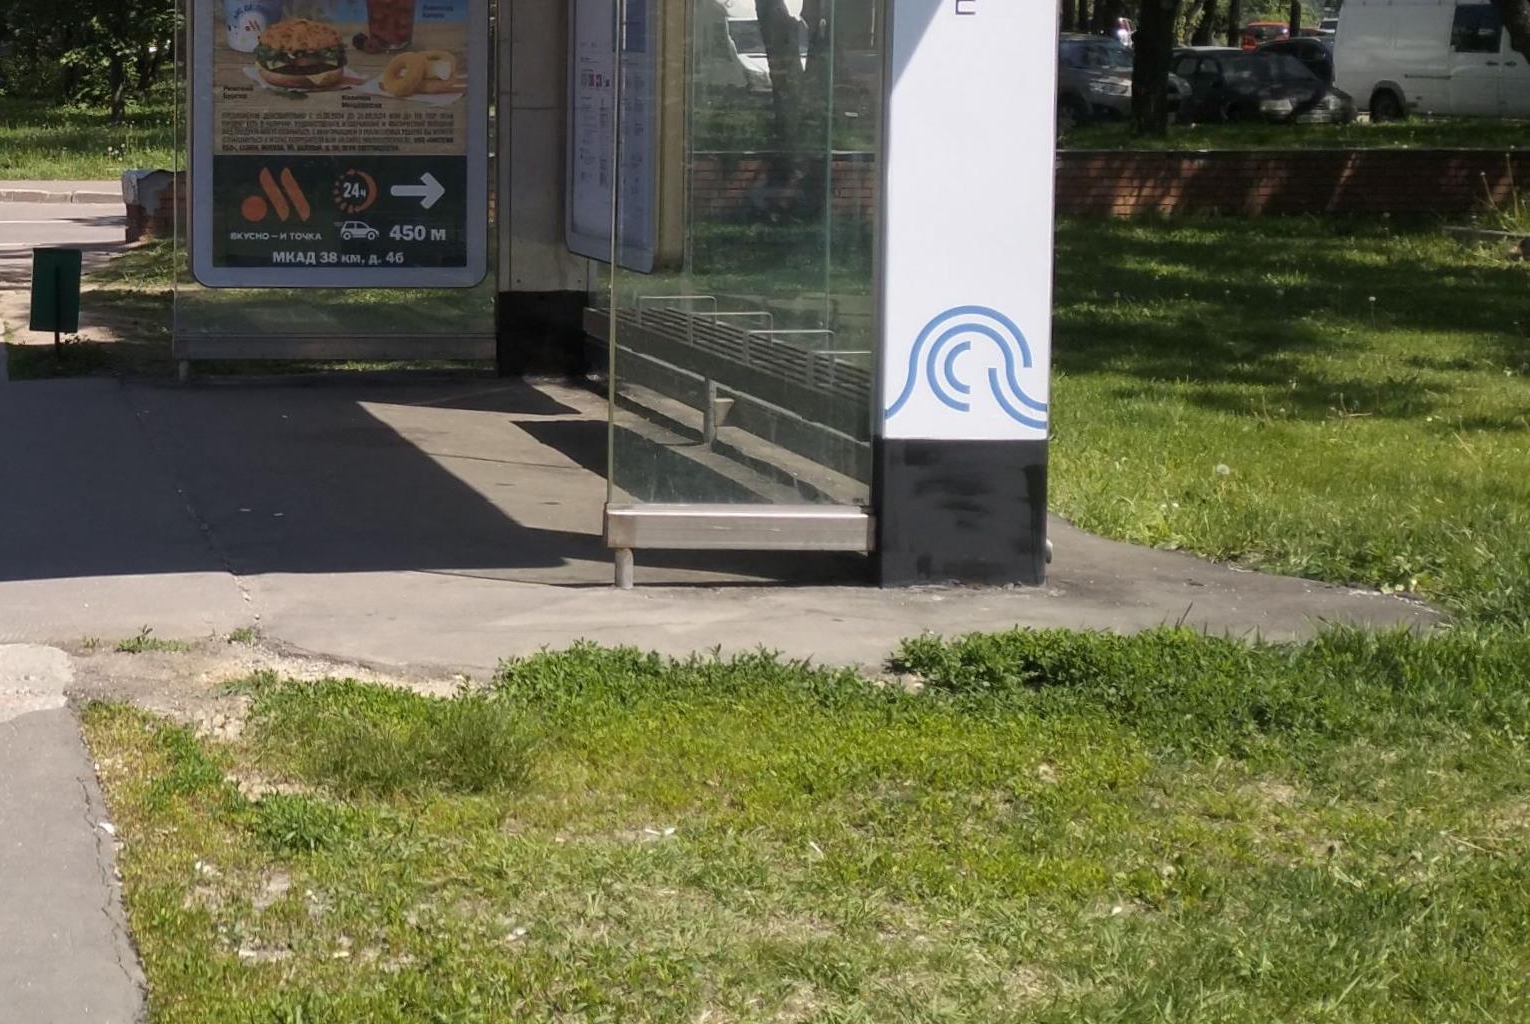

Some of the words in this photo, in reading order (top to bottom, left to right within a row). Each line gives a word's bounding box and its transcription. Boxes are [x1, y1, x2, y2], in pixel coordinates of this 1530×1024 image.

[229, 232, 271, 241] ВКУСНО
[280, 232, 287, 241] И
[289, 232, 322, 241] ТОЧКА
[389, 225, 426, 241] 450
[272, 251, 316, 265] МКАД
[319, 251, 338, 263] 38
[341, 254, 366, 265] км,
[369, 254, 382, 265] д.
